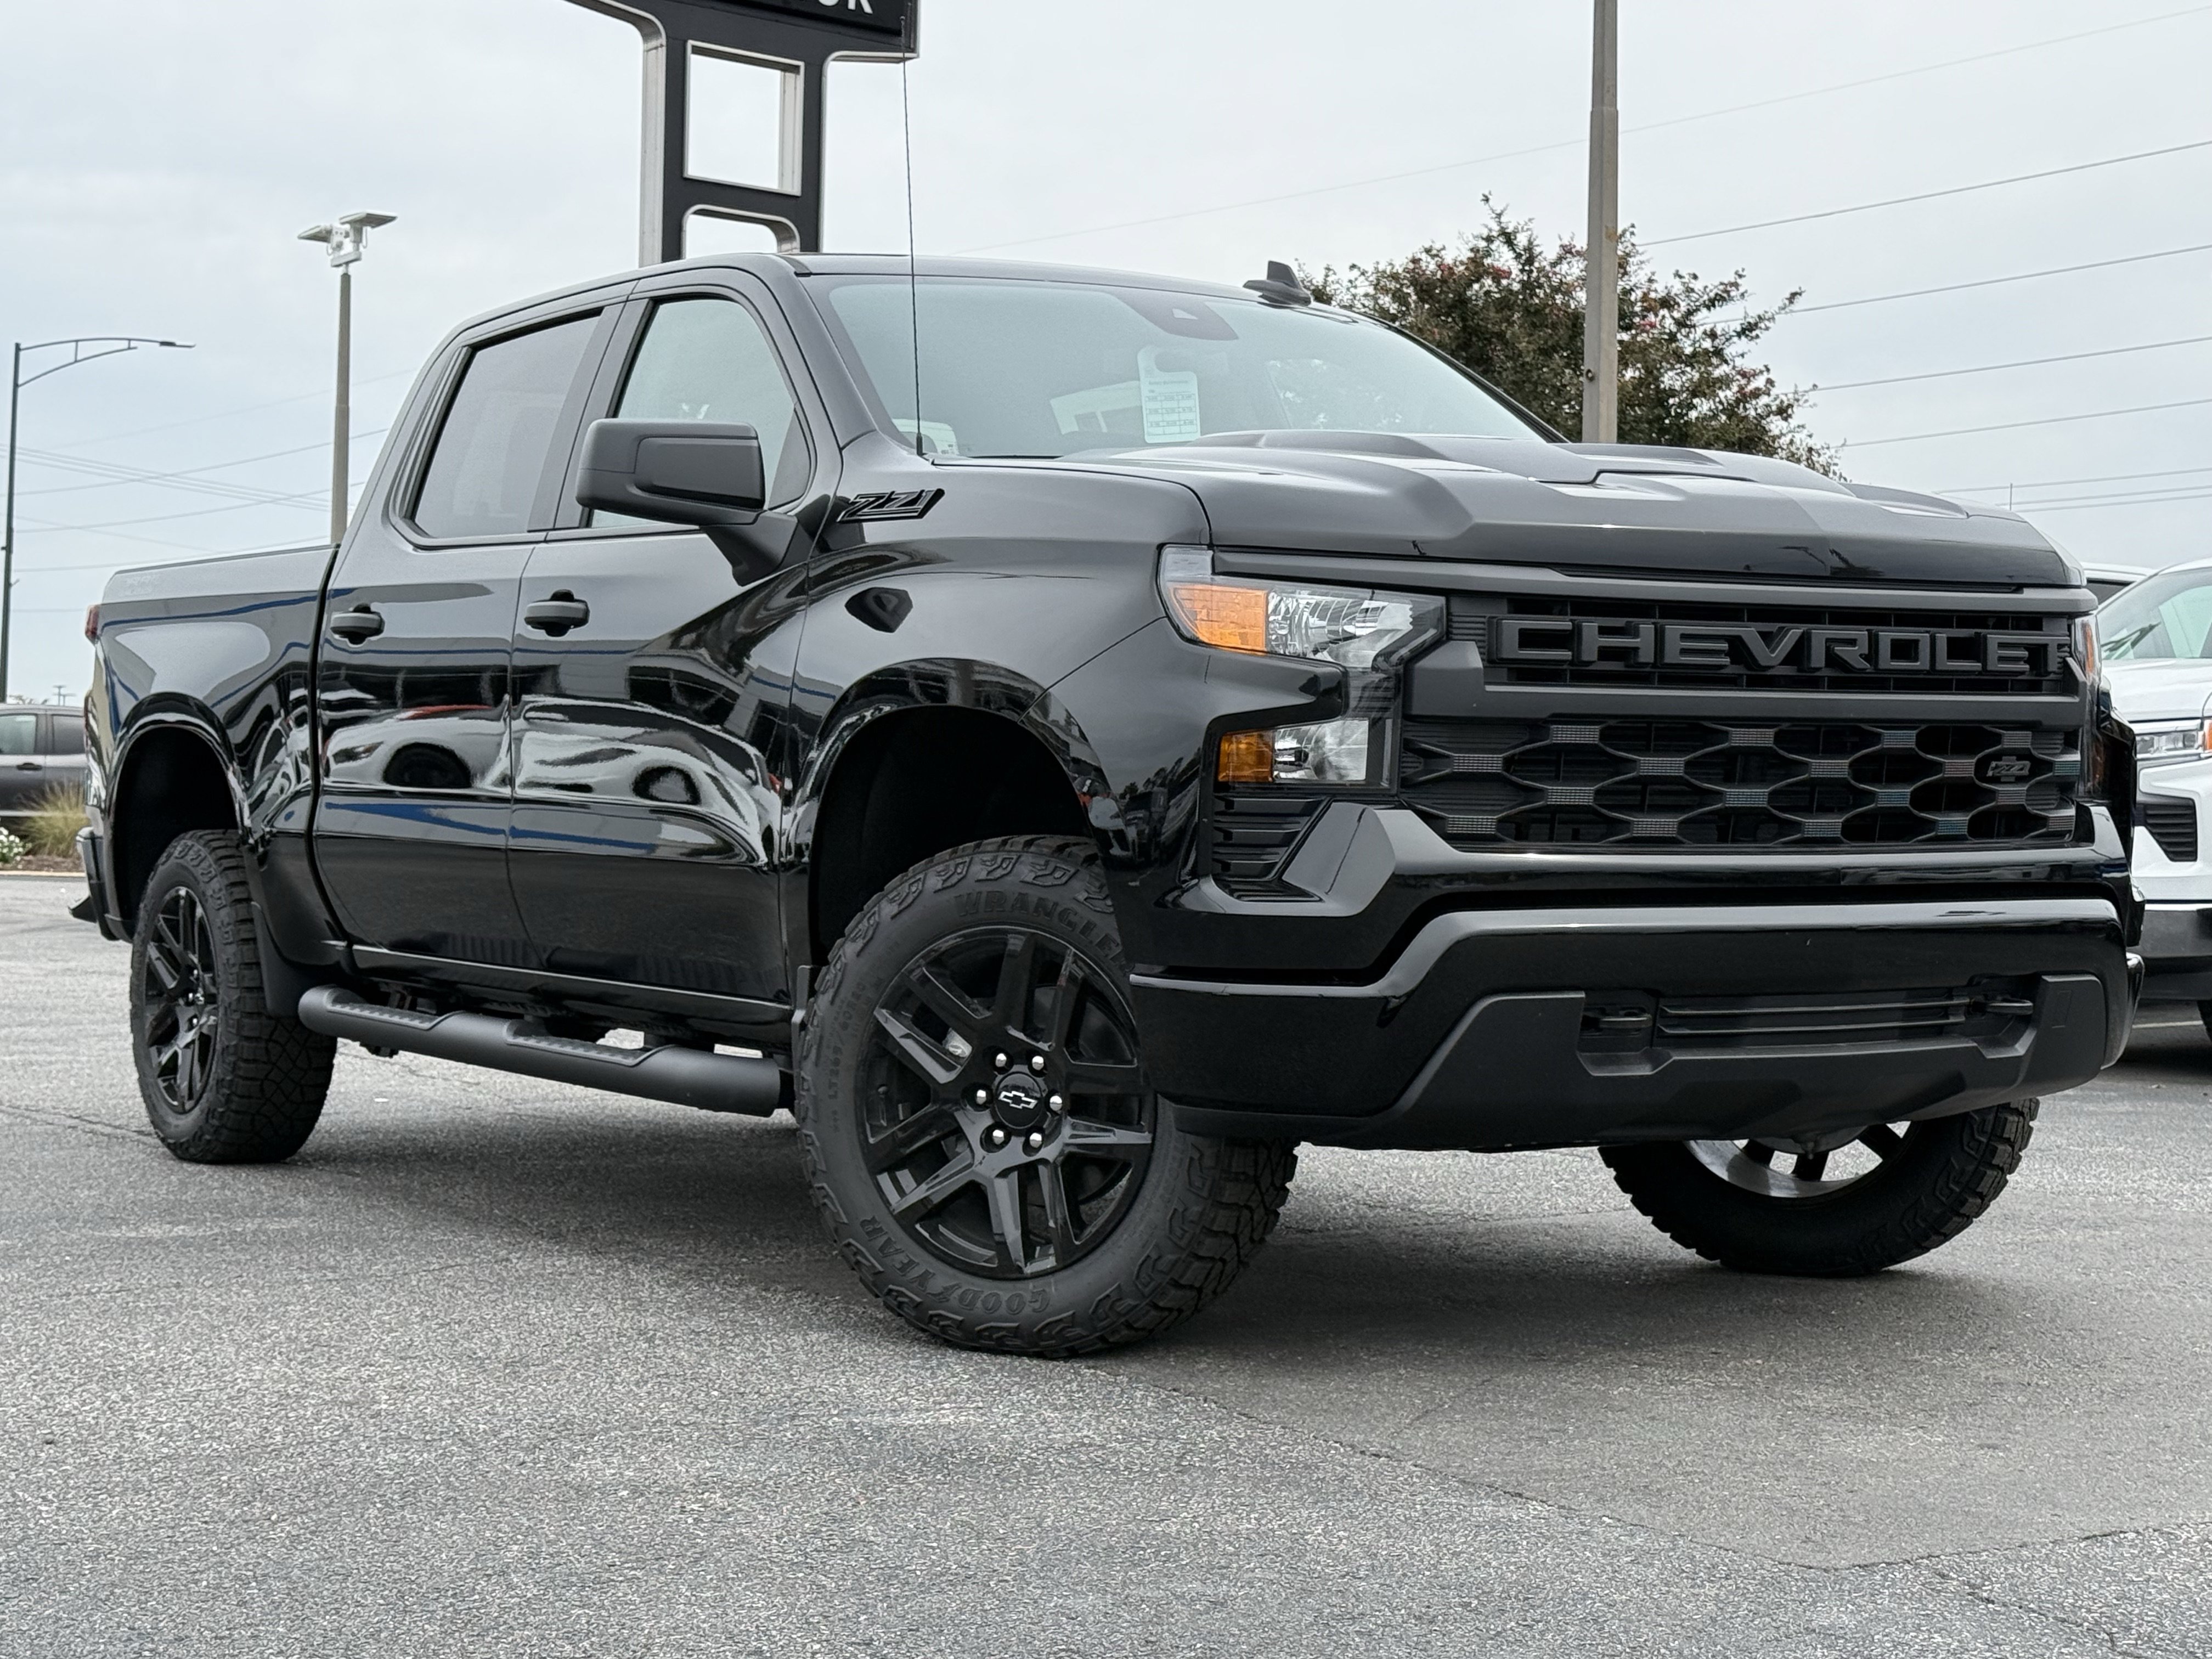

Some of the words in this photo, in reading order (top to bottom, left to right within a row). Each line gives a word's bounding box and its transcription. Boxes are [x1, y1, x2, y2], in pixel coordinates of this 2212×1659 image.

[837, 489, 945, 523] Z71
[1497, 619, 2070, 674] CHEVROLET
[860, 1216, 1049, 1313] GOODYEAR
